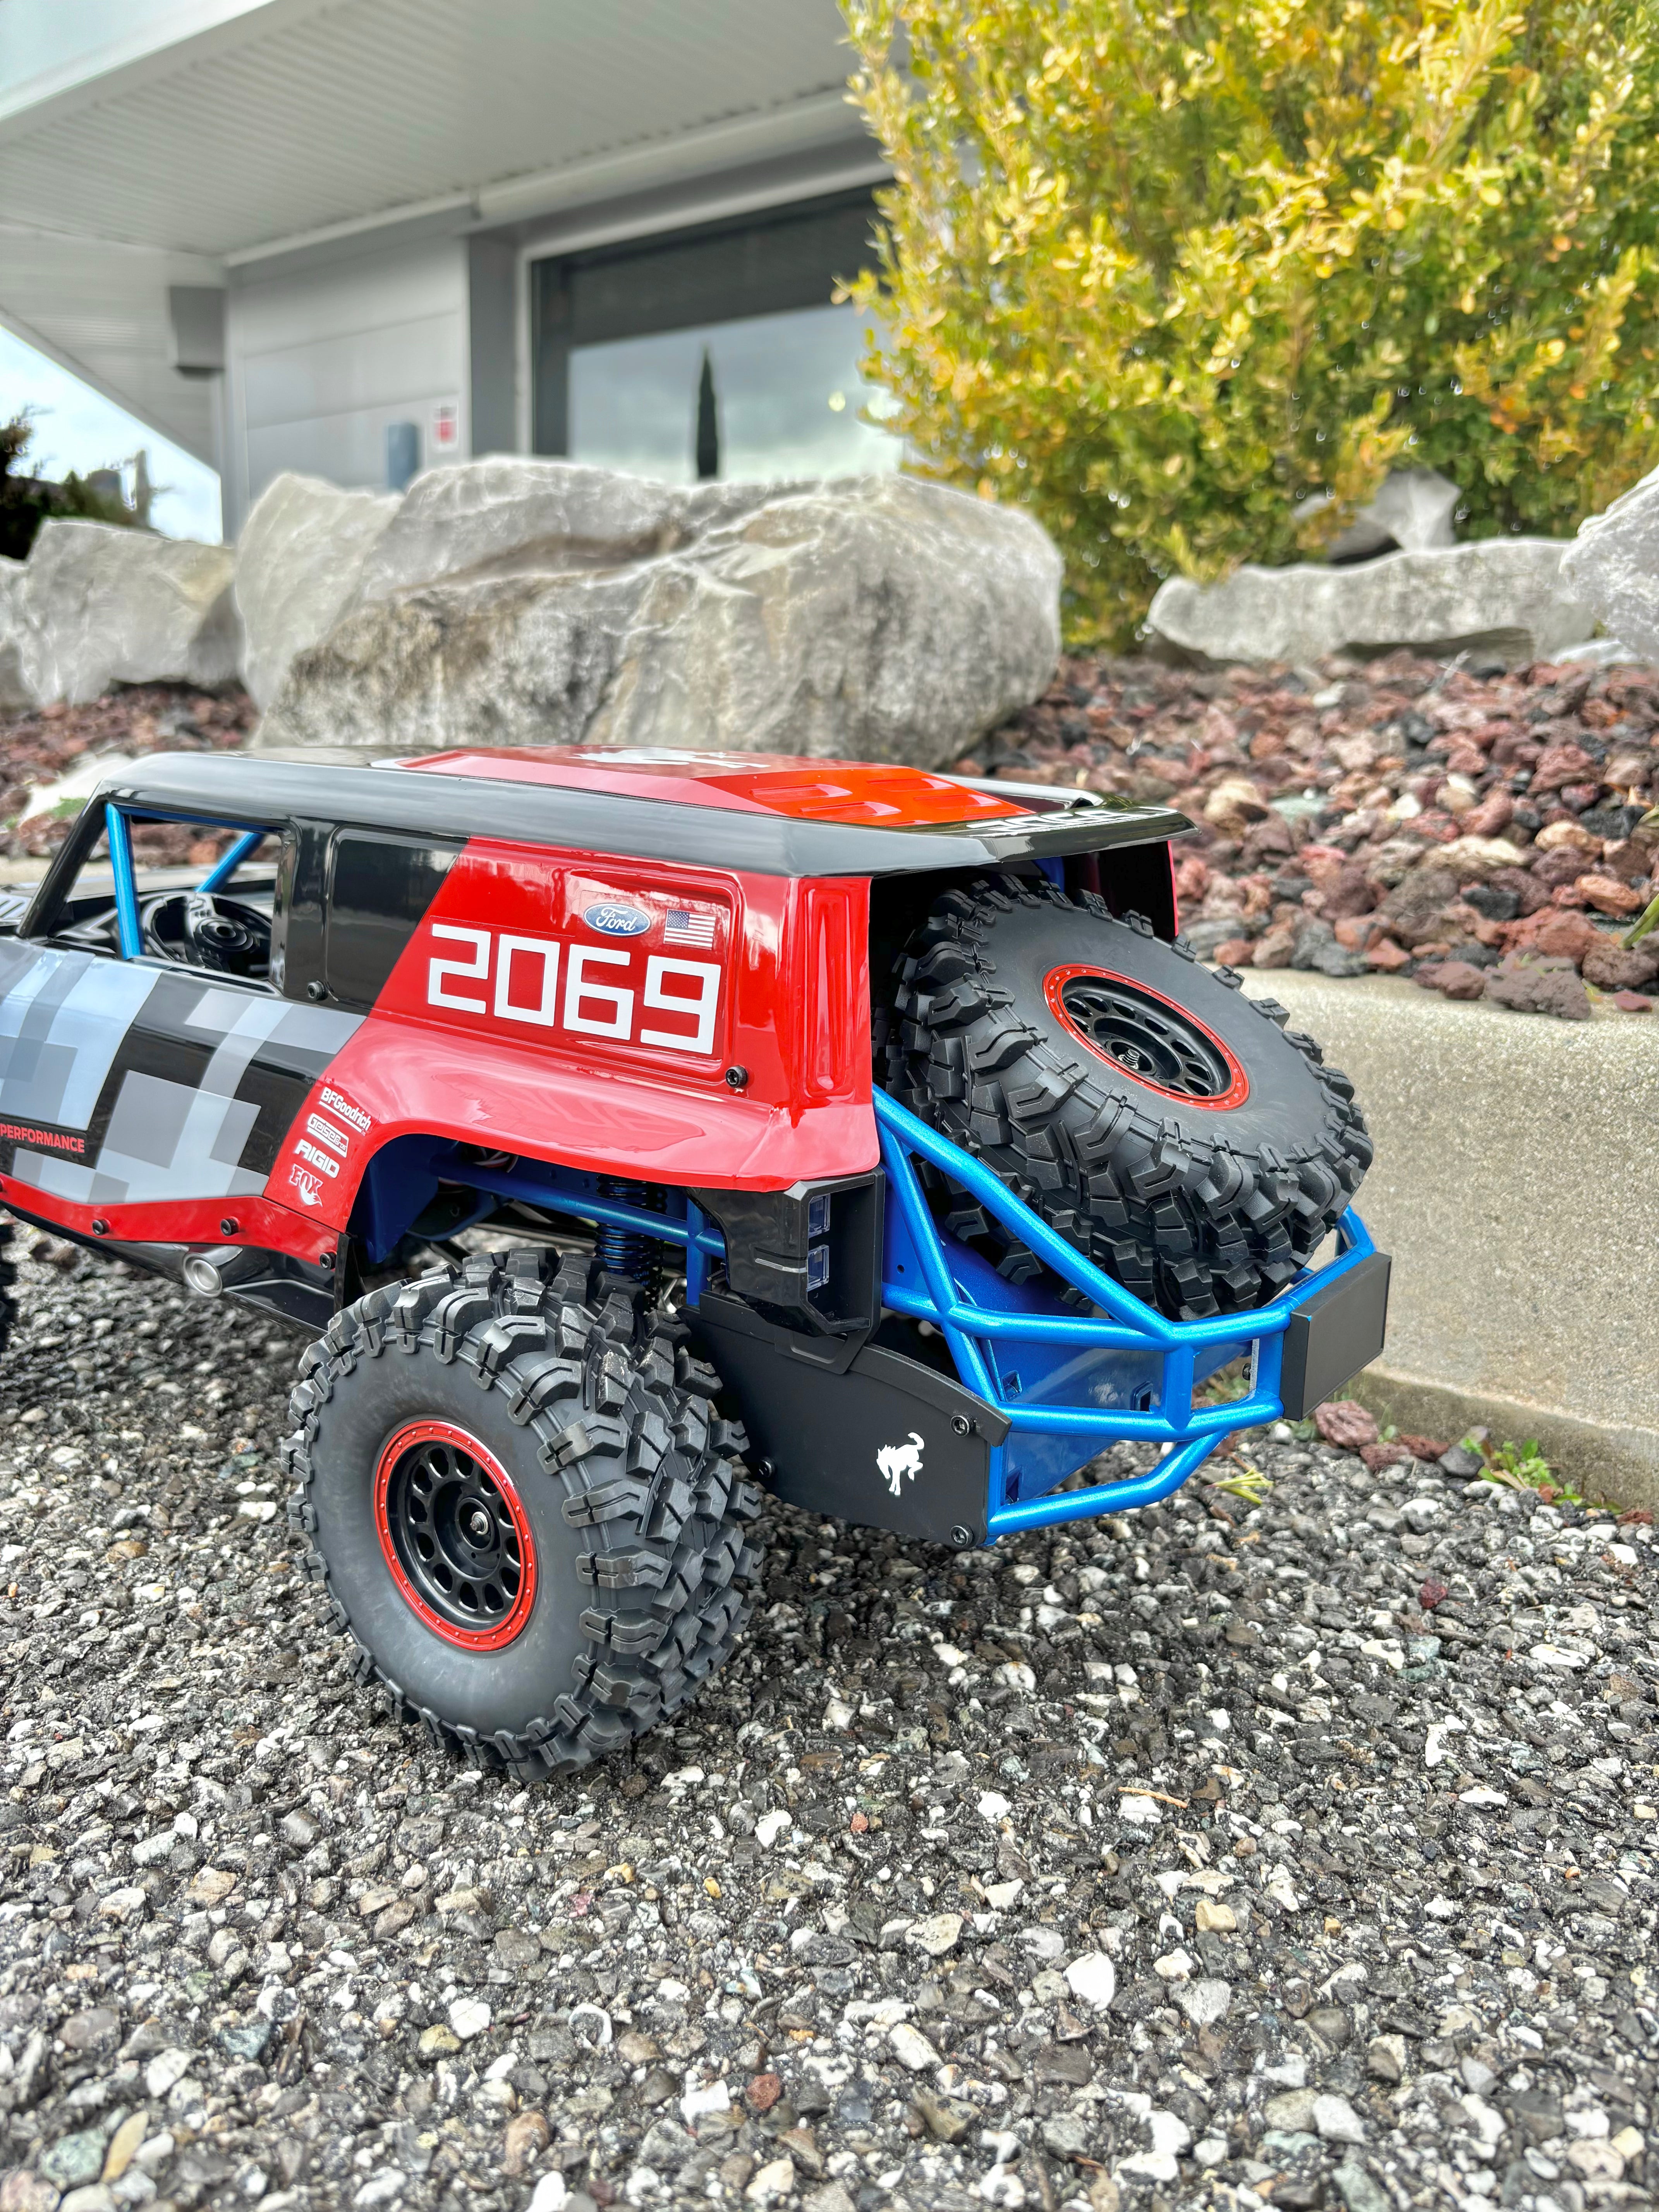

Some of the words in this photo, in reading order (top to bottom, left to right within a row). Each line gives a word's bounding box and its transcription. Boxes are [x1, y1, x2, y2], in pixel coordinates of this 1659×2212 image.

[596, 907, 637, 931] Ford
[428, 924, 721, 1054] 2069
[321, 1087, 371, 1131] BFGoodrich
[0, 1123, 85, 1153] PERFORMANCE
[295, 1139, 340, 1178] RIGID
[289, 1163, 323, 1195] FOX
